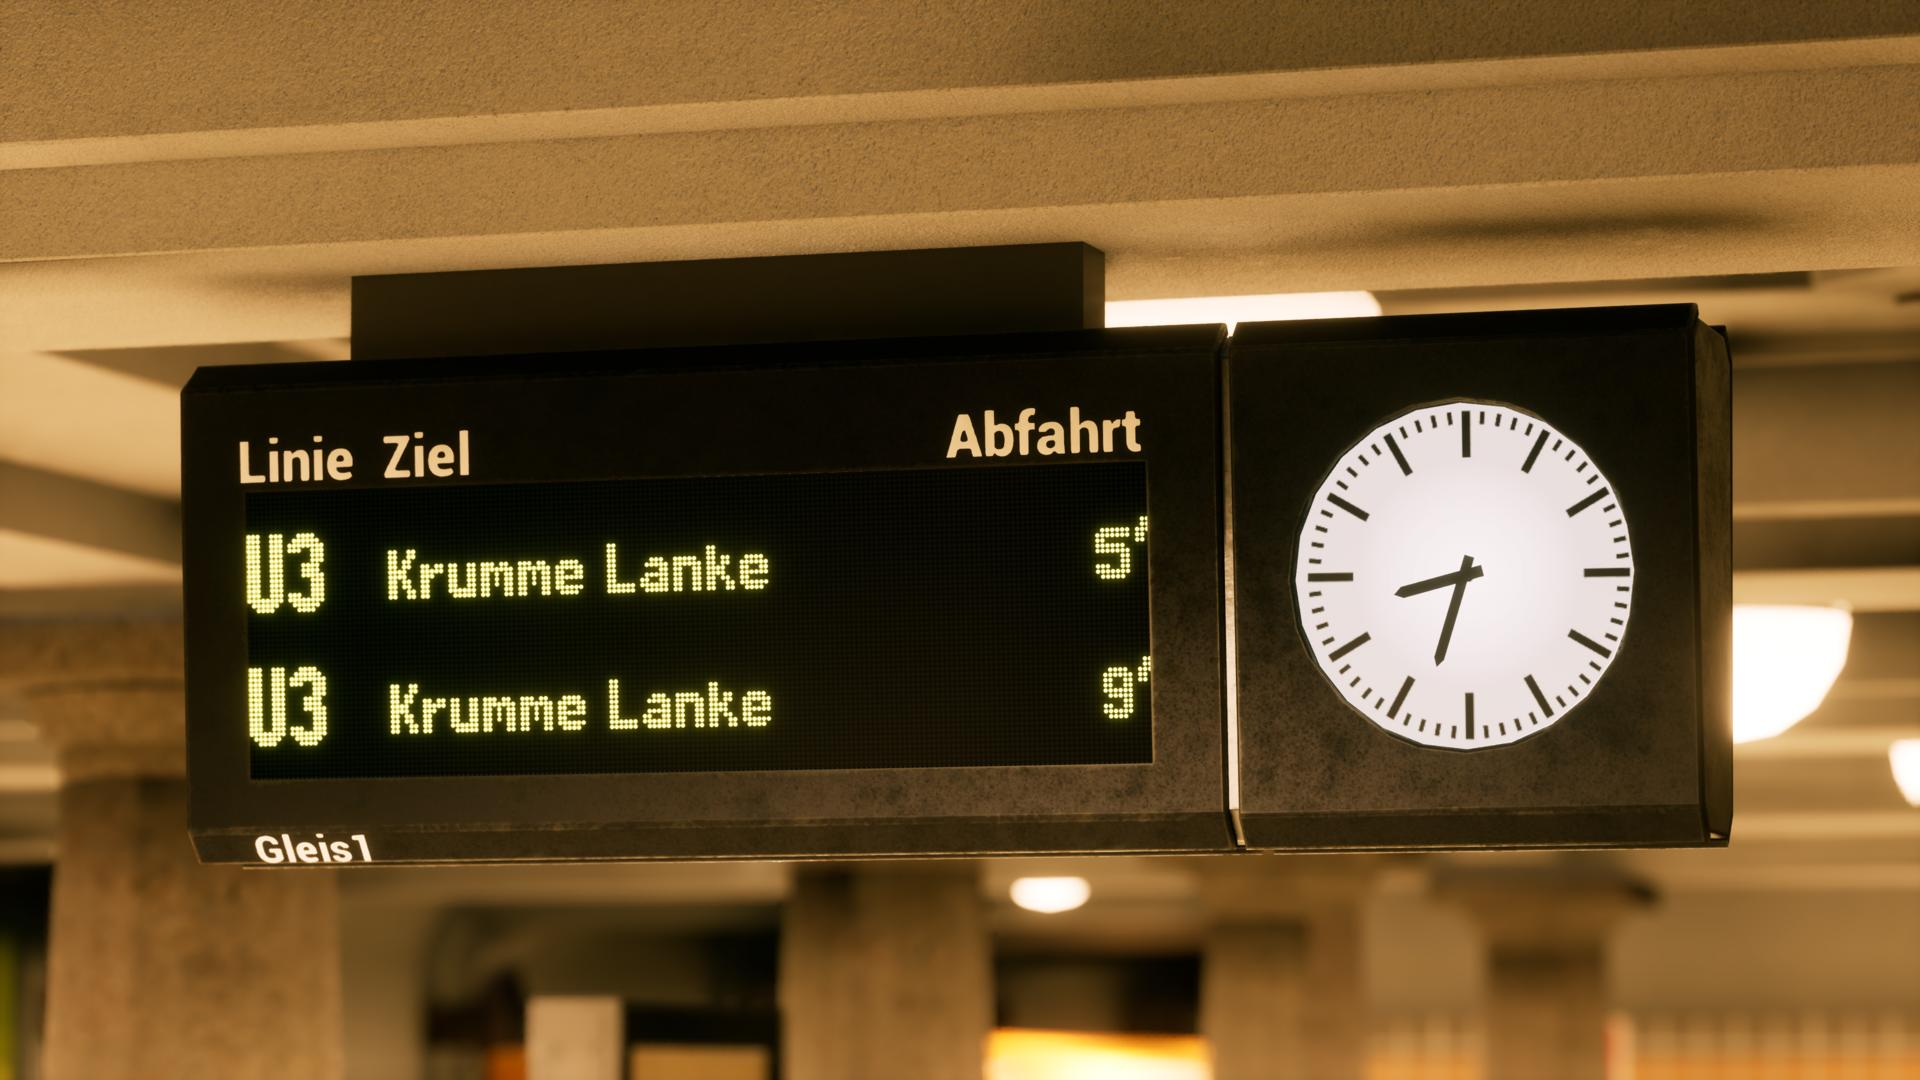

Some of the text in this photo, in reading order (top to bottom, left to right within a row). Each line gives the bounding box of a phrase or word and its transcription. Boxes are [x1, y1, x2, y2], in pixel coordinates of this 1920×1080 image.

[239, 407, 1142, 485] Linie Ziel Abfahrt
[245, 532, 326, 615] U3
[386, 548, 585, 601] Krumme
[605, 542, 770, 594] Lanke
[247, 665, 328, 748] U3
[388, 683, 587, 735] Krumme
[607, 678, 773, 731] Lanke
